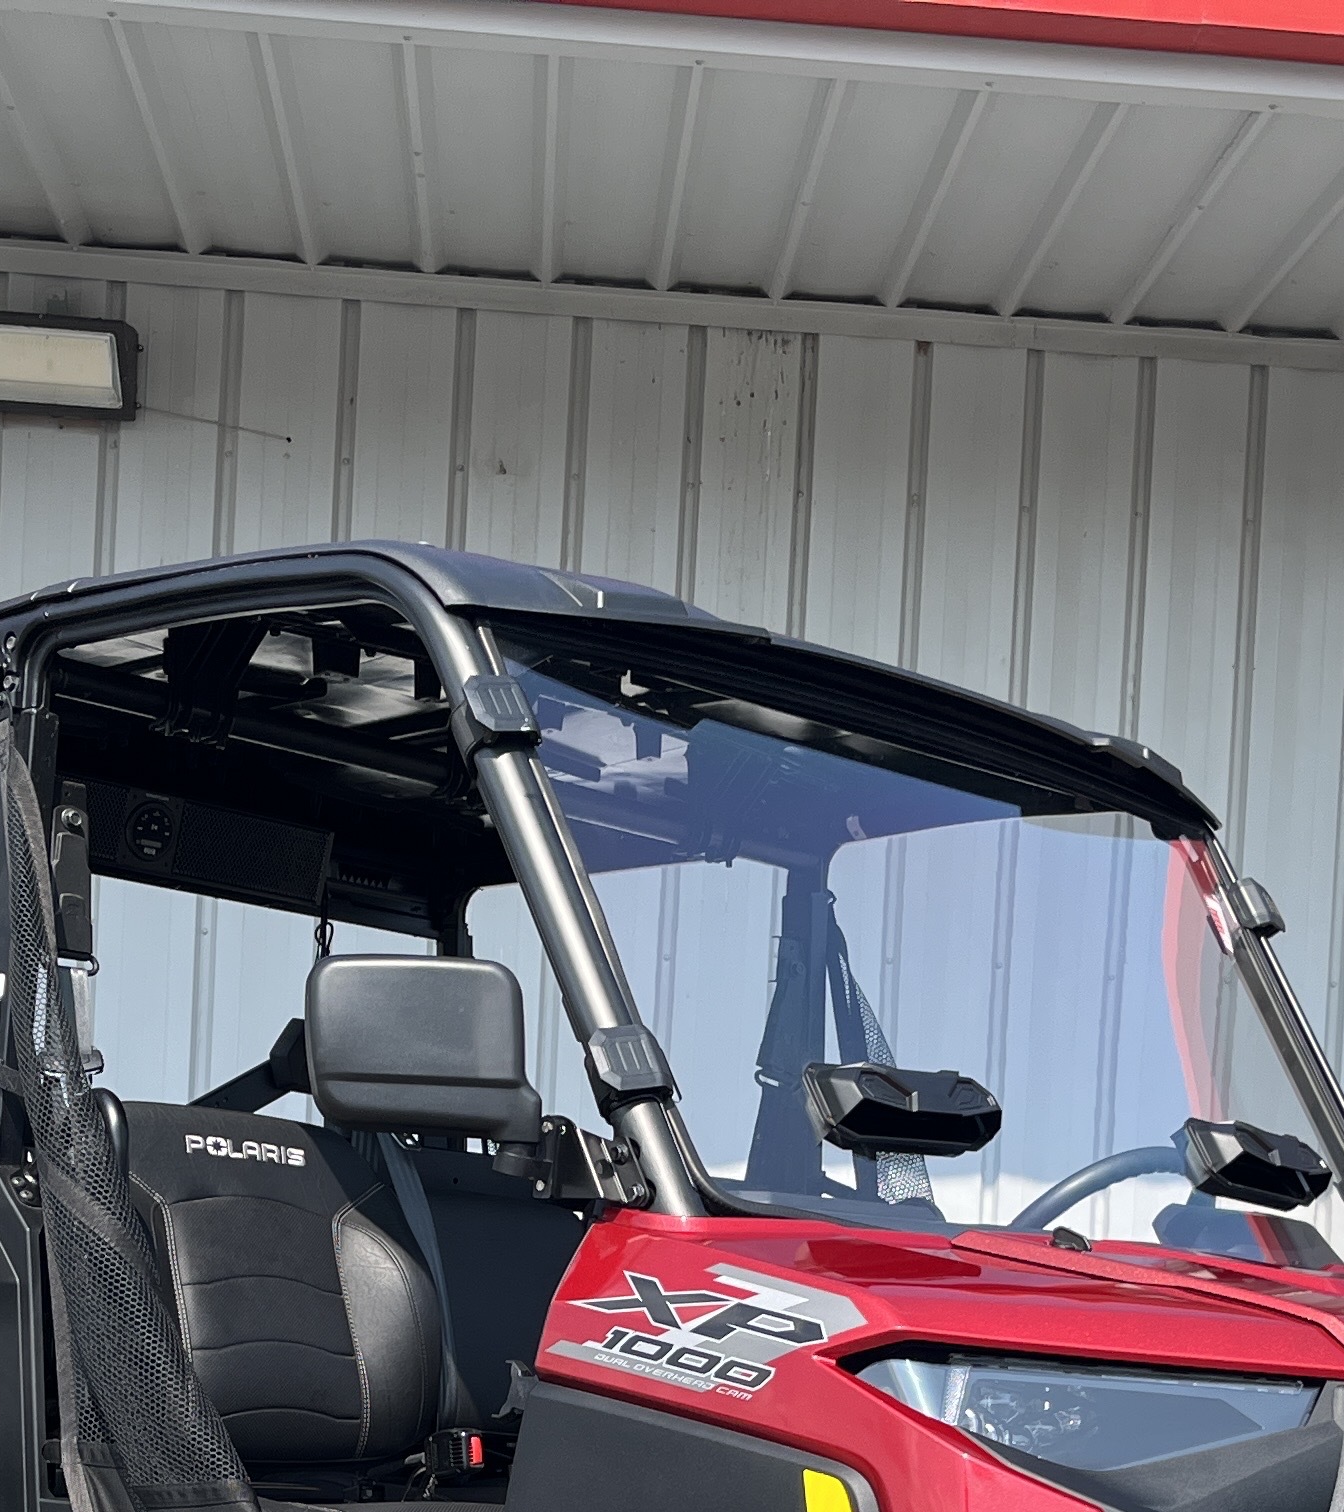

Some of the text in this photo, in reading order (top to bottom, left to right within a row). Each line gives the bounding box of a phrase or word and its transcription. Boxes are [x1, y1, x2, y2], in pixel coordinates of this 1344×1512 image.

[184, 1135, 306, 1167] POLARIS
[566, 1269, 828, 1344] XP
[593, 1352, 754, 1402] DUAL OVERHEAD CAM
[600, 1326, 776, 1390] 1000
